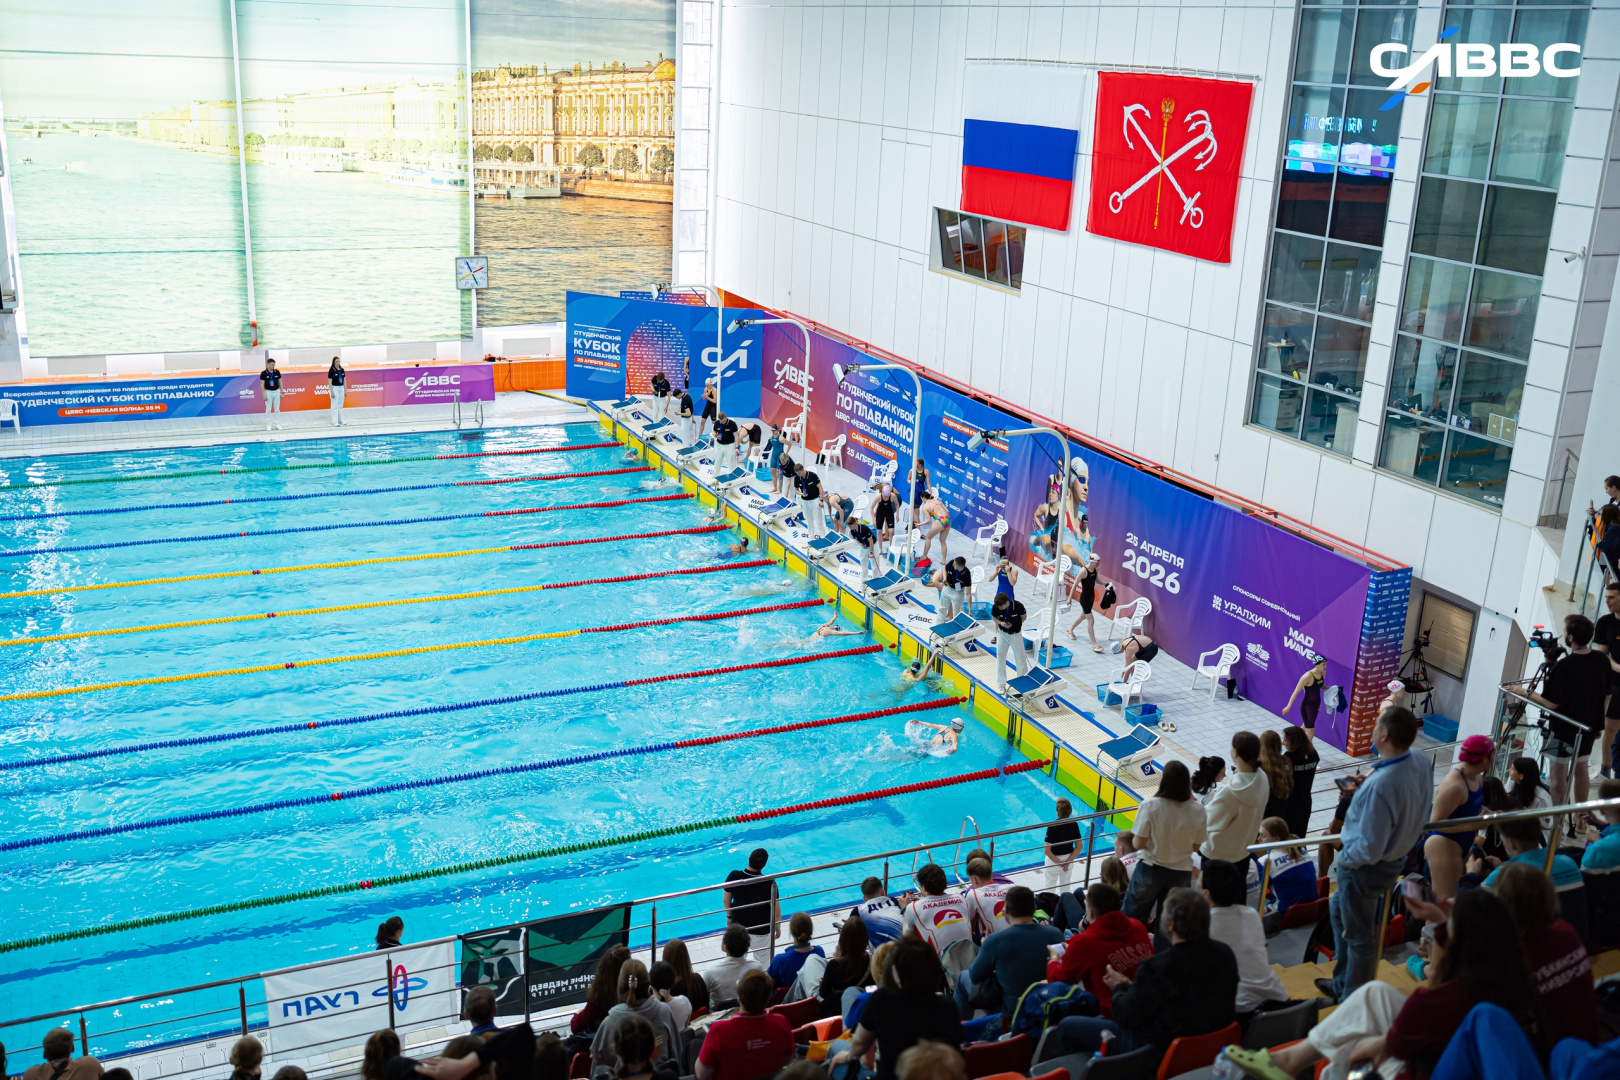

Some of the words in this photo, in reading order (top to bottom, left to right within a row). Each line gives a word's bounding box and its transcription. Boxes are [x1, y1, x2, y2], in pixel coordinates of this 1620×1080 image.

[573, 330, 621, 341] СТУДЕНЧЕСКИЙ
[573, 337, 620, 353] КУБОК
[584, 350, 621, 361] ПЛАВАНИЮ
[3, 389, 60, 398] Всероссийские
[122, 385, 156, 393] плаванию
[179, 382, 214, 390] студентов
[16, 395, 96, 408] УДЕНЧЕСКИЙ
[97, 393, 134, 403] КУБОК
[136, 393, 152, 401] ПО
[153, 390, 215, 400] ПЛАВАНИЮ
[836, 392, 852, 411] ПО
[853, 400, 914, 443] ПЛАВАНИЮ
[891, 404, 915, 424] КУБОК
[835, 410, 851, 423] ЦВВС
[899, 442, 907, 453] 25
[906, 447, 913, 456] М
[847, 447, 855, 457] 25
[851, 432, 895, 458] САНКТ-ПЕТЕРБУРГ
[1125, 532, 1139, 547] 25
[1139, 540, 1185, 569] АПРЕЛЯ
[1122, 548, 1180, 594] 2026
[898, 595, 904, 603] 6
[1232, 585, 1261, 602] СПОНСОРЫ
[1261, 598, 1301, 621] СОРЕВНОВАНИЙ
[1223, 600, 1272, 629] УРАЛХИМ
[1288, 626, 1315, 648] MAD
[967, 642, 973, 651] 7
[1283, 636, 1316, 660] WAVE
[1048, 698, 1054, 707] 8
[1144, 764, 1151, 774] 9
[923, 898, 963, 910] АКАДЕМИЯ
